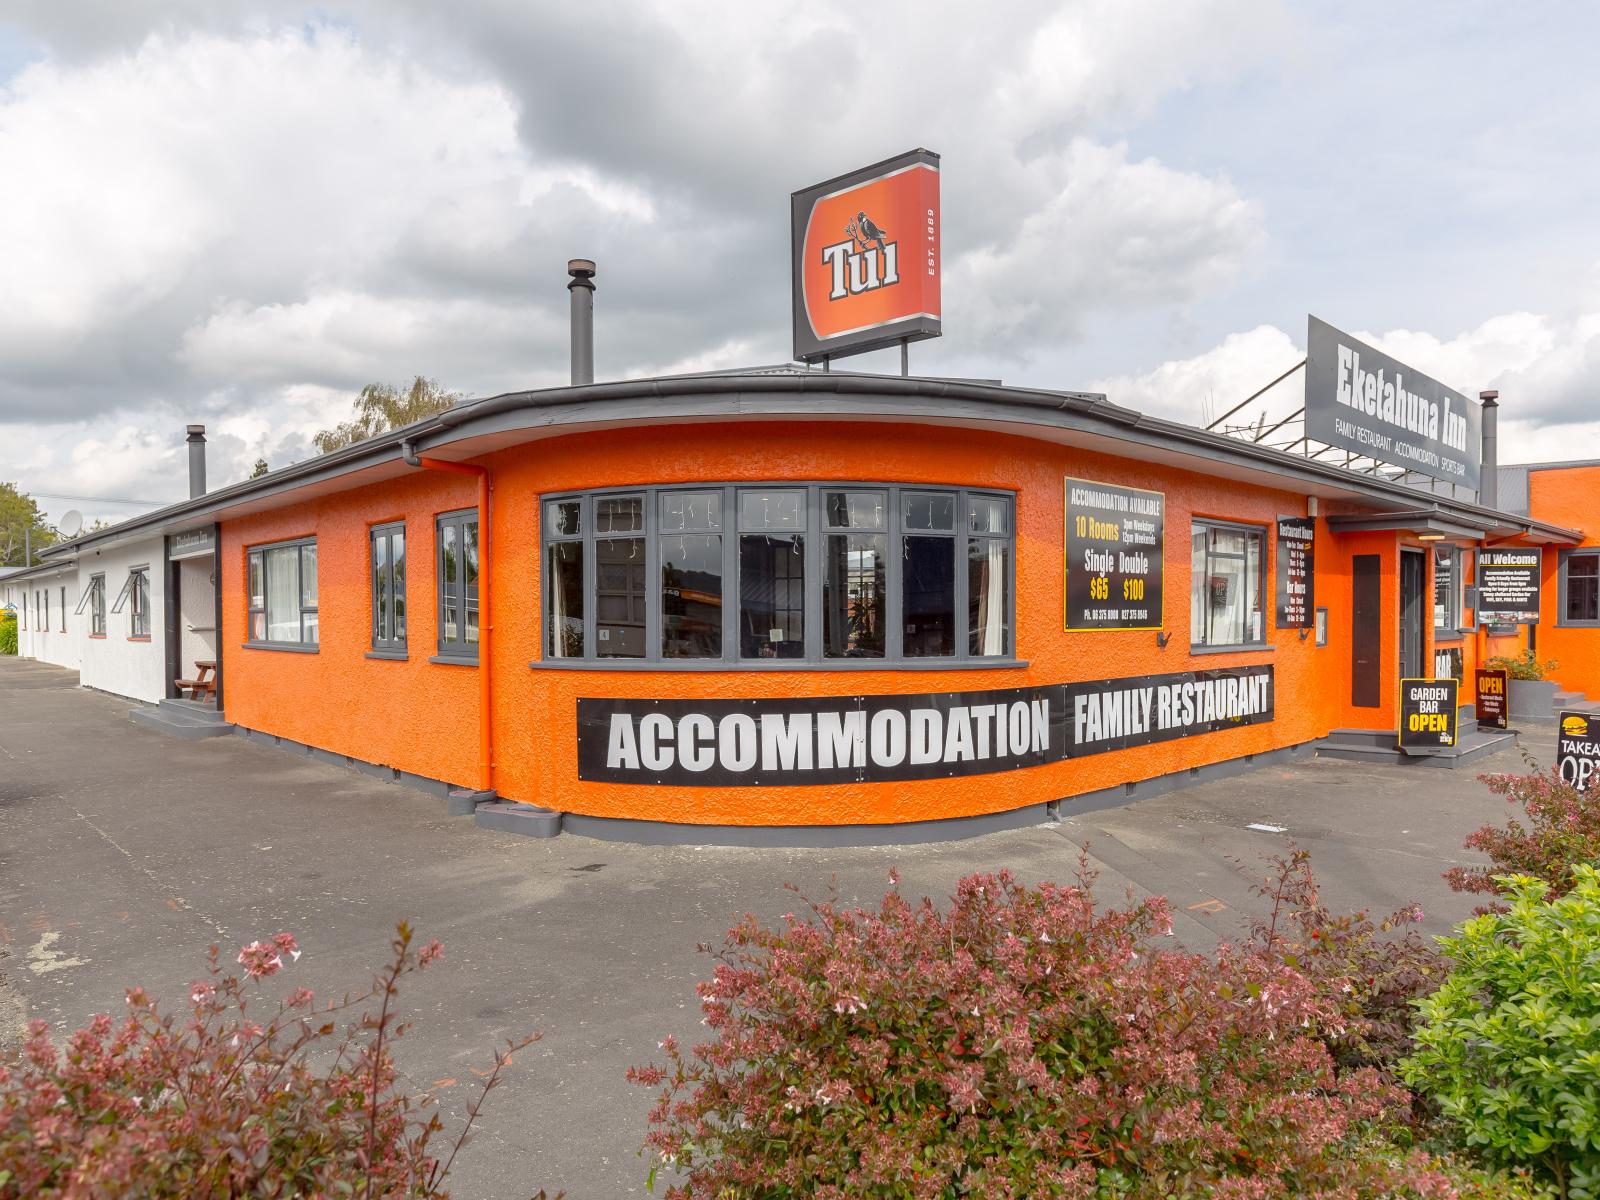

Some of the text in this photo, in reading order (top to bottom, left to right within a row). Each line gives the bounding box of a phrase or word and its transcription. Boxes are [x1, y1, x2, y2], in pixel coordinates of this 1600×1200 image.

[927, 208, 935, 276] EST. 1889
[821, 239, 900, 302] Tui
[1336, 343, 1467, 452] Eketahuna Inn
[1335, 418, 1466, 476] FAMILY RESTAURANT ACCOMMODATION SPORTS BAR
[1071, 488, 1160, 516] ACCOMMODATION AVAILABLE
[1075, 515, 1120, 541] 10 Rooms
[1279, 522, 1314, 541] Restaurant Hours
[1084, 549, 1149, 578] Single Double
[1479, 553, 1538, 565] All Welcome
[1090, 577, 1144, 601] $65 $100
[1435, 654, 1452, 679] BAR
[1410, 687, 1448, 701] GARDEN
[1479, 676, 1504, 694] OPEN
[1419, 700, 1439, 714] BAR
[606, 674, 1270, 772] ACCOMMODATION FAMILY RESTAURANT
[1409, 713, 1448, 732] OPEN
[1560, 739, 1600, 757] TAKEA
